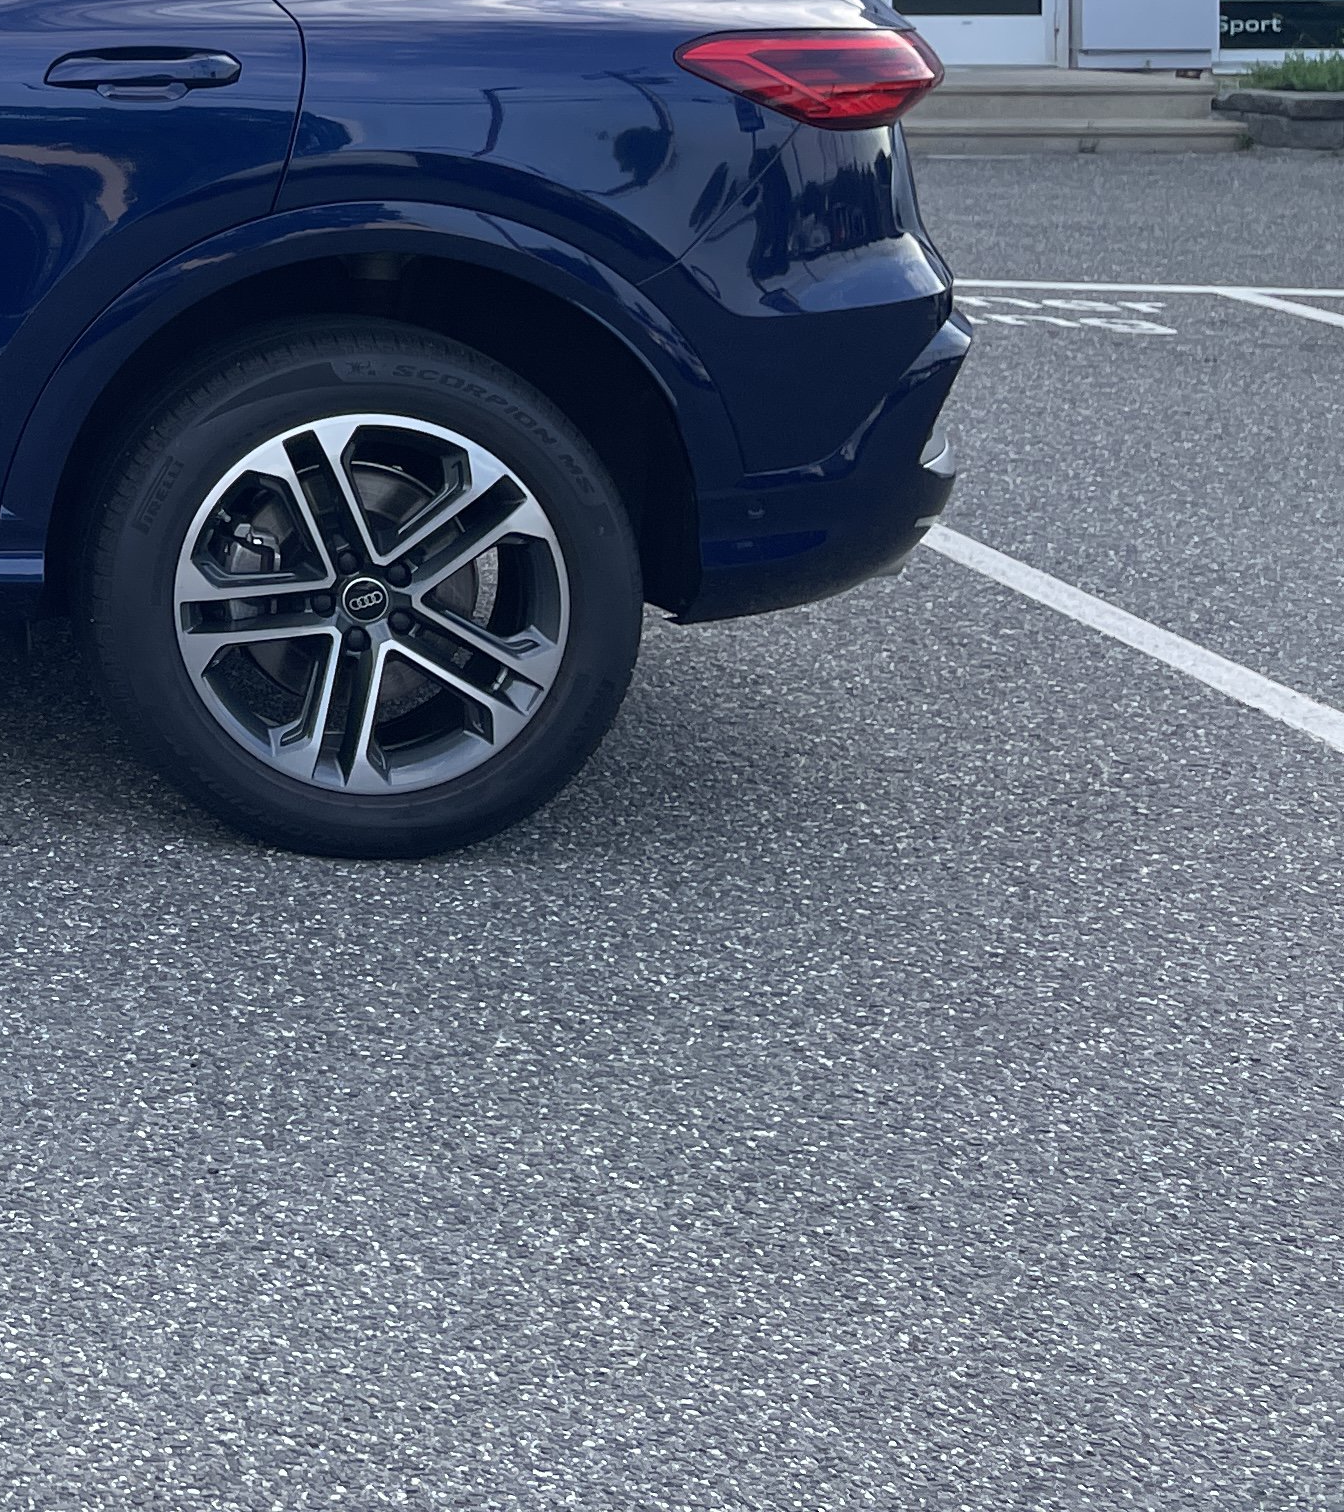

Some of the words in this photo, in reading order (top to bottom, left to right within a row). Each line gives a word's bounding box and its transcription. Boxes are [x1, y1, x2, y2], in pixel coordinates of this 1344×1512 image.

[1220, 15, 1282, 36] Sport
[392, 363, 557, 445] SCORPION
[559, 452, 596, 495] MS
[132, 455, 185, 536] PIRELLI
